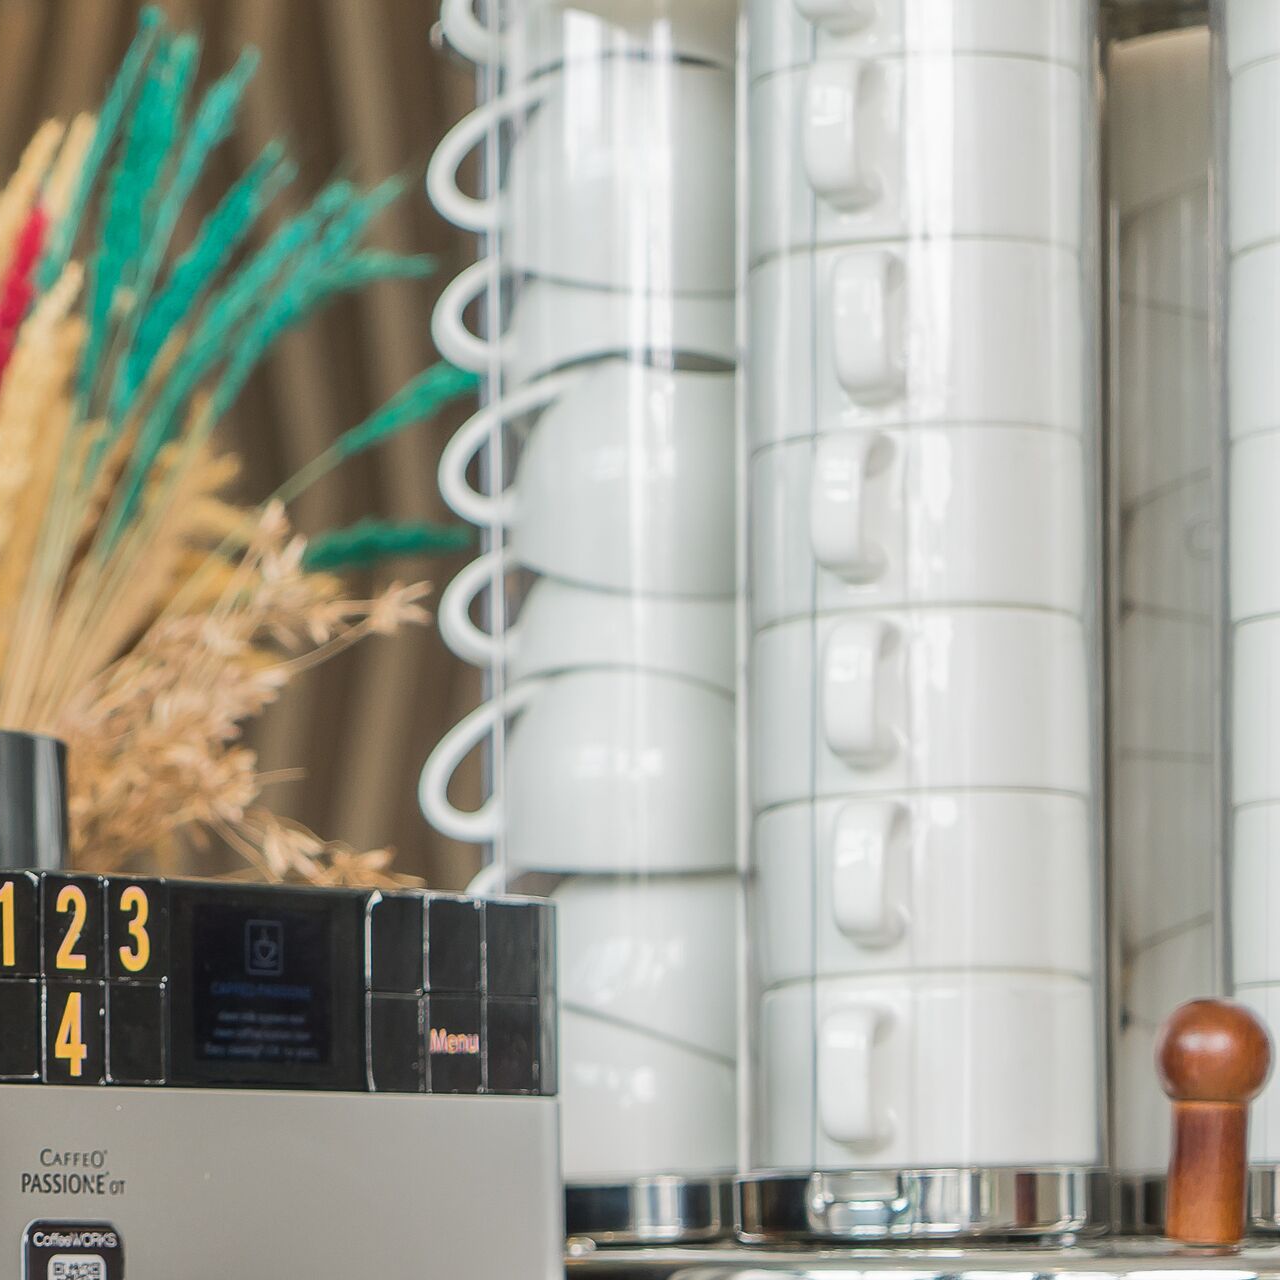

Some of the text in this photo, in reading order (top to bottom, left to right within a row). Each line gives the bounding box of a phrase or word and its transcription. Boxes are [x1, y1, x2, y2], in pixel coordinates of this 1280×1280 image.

[56, 885, 87, 969] 2
[119, 886, 150, 972] 3
[55, 992, 87, 1076] 4
[429, 1028, 479, 1054] Menu
[21, 1173, 105, 1194] PASSIONE
